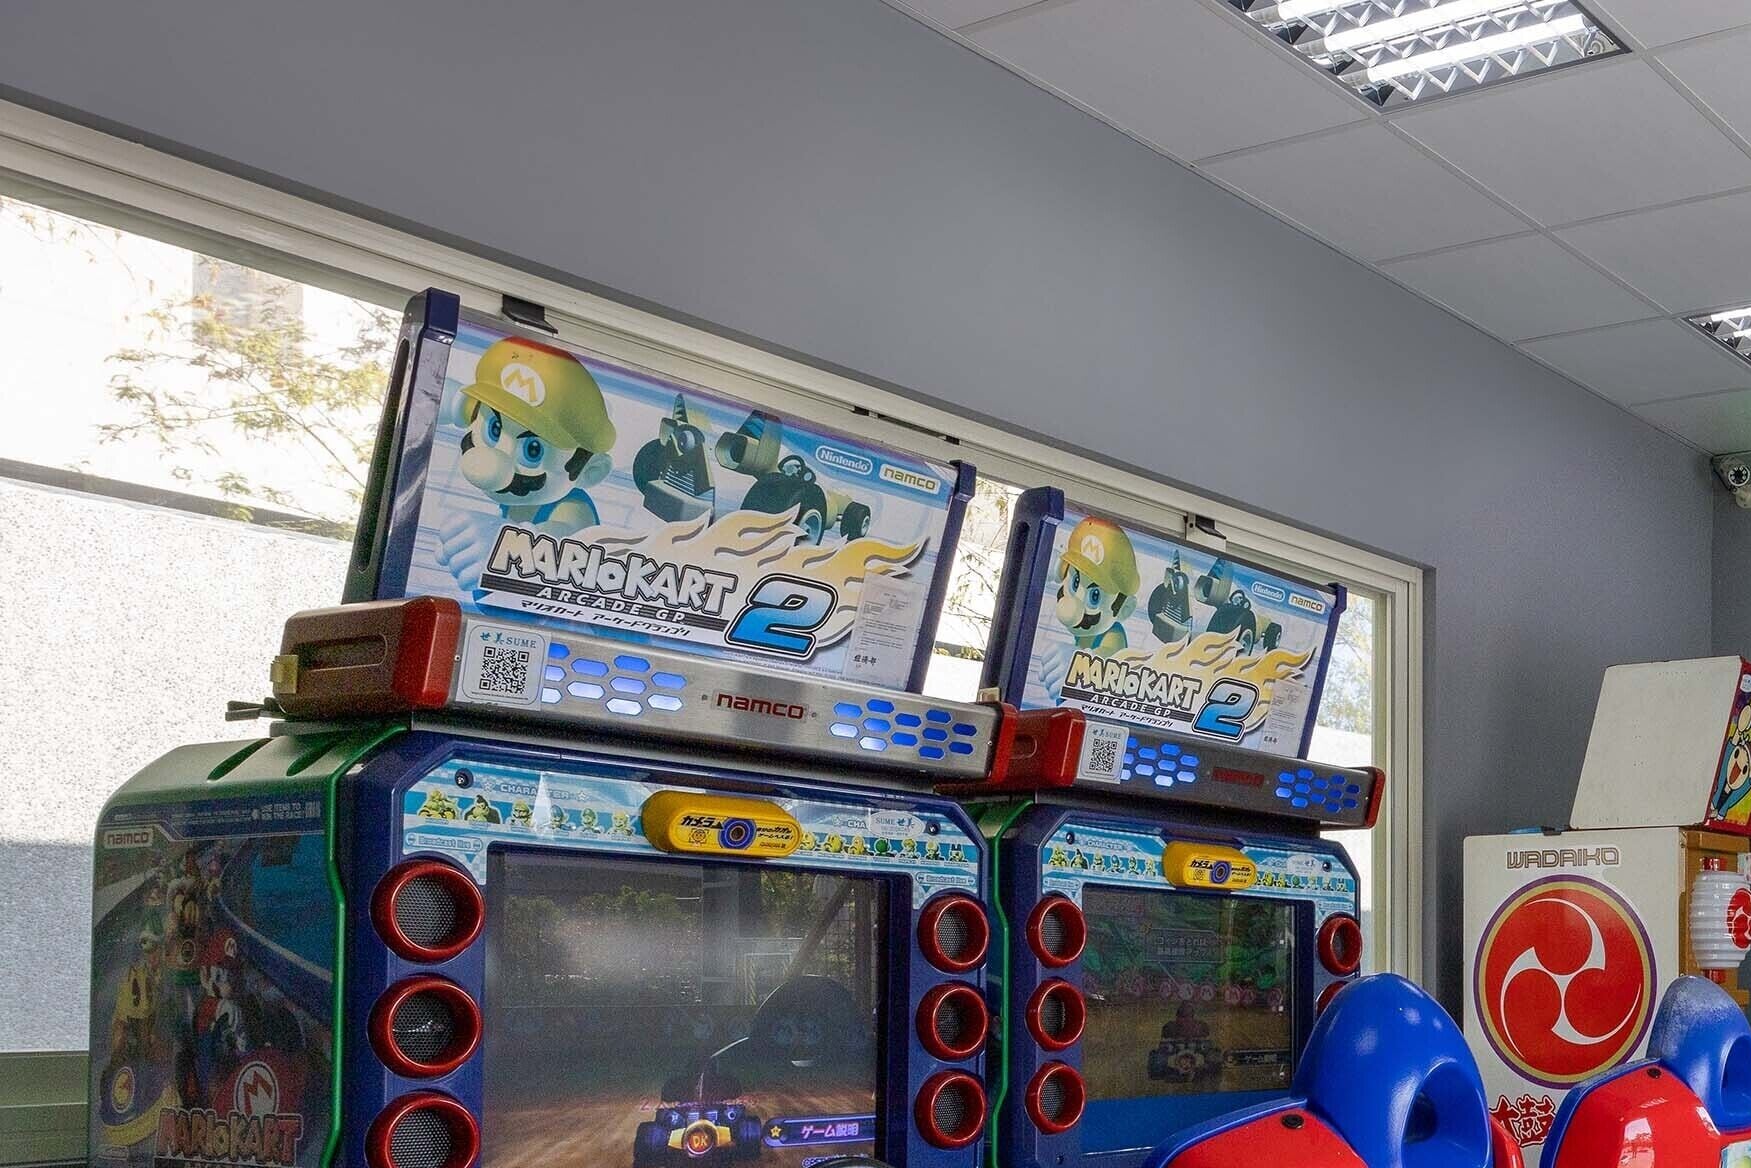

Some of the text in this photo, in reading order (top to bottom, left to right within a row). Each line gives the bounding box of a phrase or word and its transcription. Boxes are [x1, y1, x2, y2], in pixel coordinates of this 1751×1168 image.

[820, 449, 936, 490] Nintendo namco
[520, 599, 585, 618] マリオカート
[536, 586, 687, 625] ARCADE GP
[1291, 595, 1323, 611] namco
[726, 573, 839, 658] 2
[506, 636, 537, 648] SUME
[717, 692, 805, 720] namco
[1090, 693, 1154, 714] ARCADE
[1191, 677, 1261, 743] 2
[681, 814, 715, 828] カメラ
[106, 831, 150, 846] namco
[1506, 847, 1620, 869] WADAIKO
[801, 1122, 860, 1139] ゲーム説明
